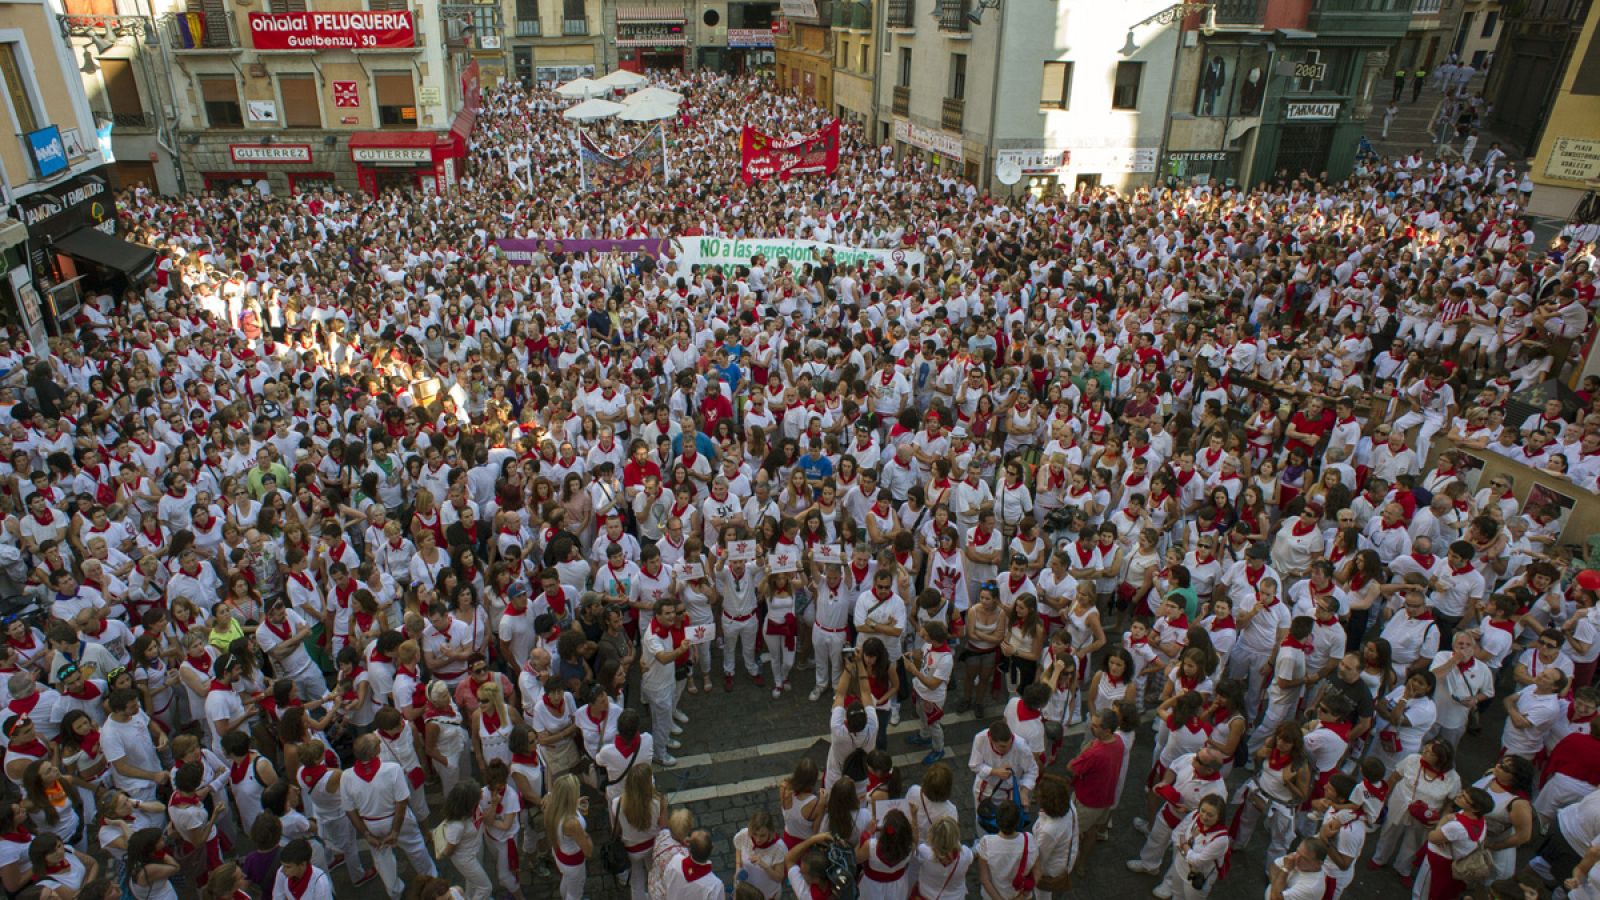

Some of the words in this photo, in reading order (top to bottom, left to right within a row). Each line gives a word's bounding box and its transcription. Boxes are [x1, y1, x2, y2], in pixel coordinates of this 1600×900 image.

[251, 15, 308, 32] ohlala!
[314, 13, 410, 31] PELUQUERIA
[362, 35, 377, 46] 30
[1290, 104, 1334, 117] FARMACIA
[237, 148, 304, 158] GUTIERREZ
[359, 149, 425, 159] GUTIERREZ
[1170, 152, 1226, 161] GUTIERREZ
[700, 239, 720, 258] NO
[723, 243, 730, 257] a
[733, 239, 752, 258] las
